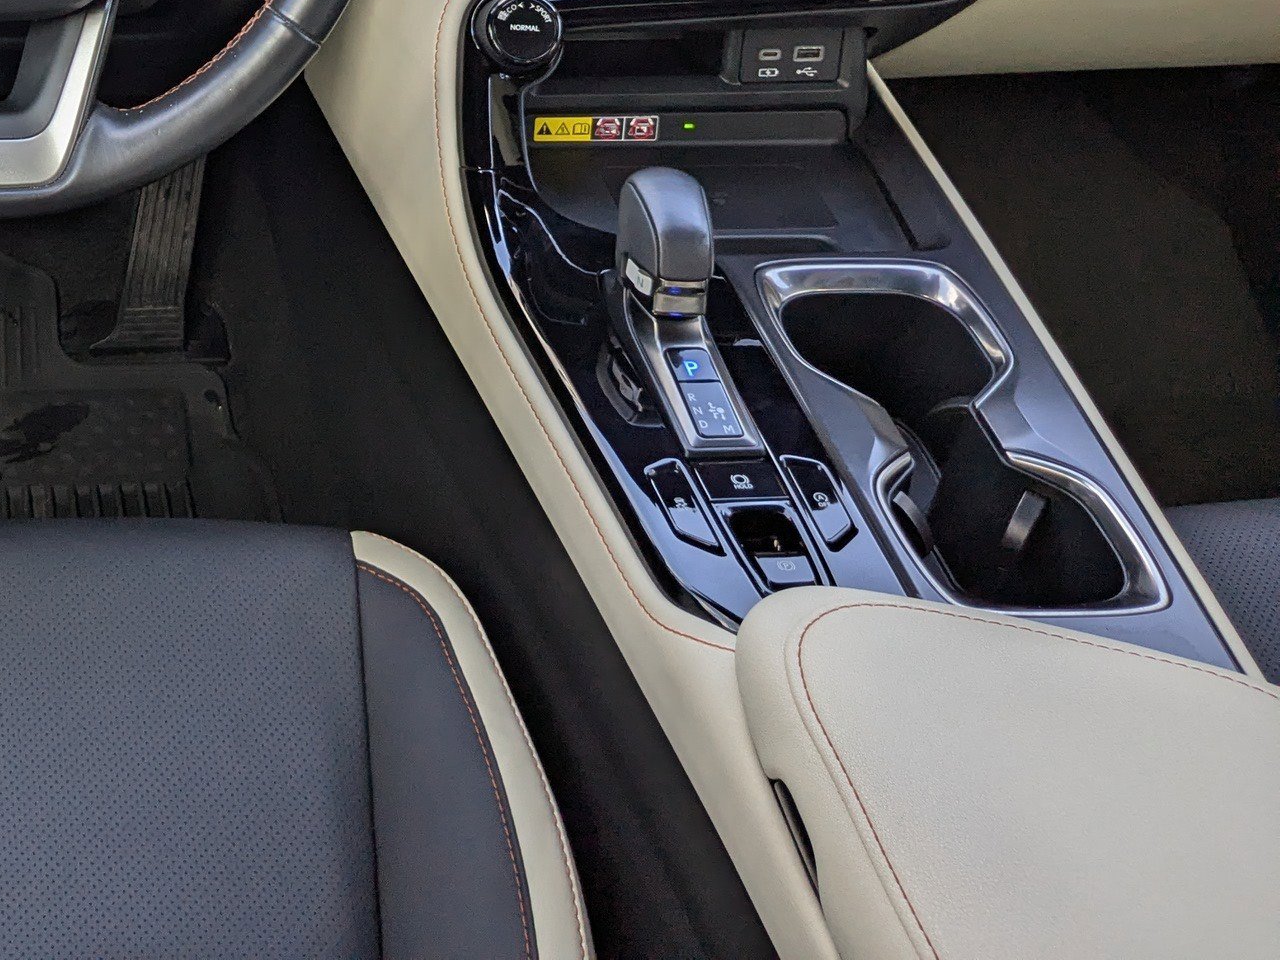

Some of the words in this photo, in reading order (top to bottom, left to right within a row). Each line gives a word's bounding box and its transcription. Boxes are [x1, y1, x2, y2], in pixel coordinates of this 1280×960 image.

[535, 5, 553, 23] SPORT
[510, 23, 541, 32] NORMAL
[683, 360, 699, 377] P
[687, 393, 696, 401] R
[692, 406, 703, 415] N
[698, 420, 708, 429] D
[722, 424, 736, 434] M
